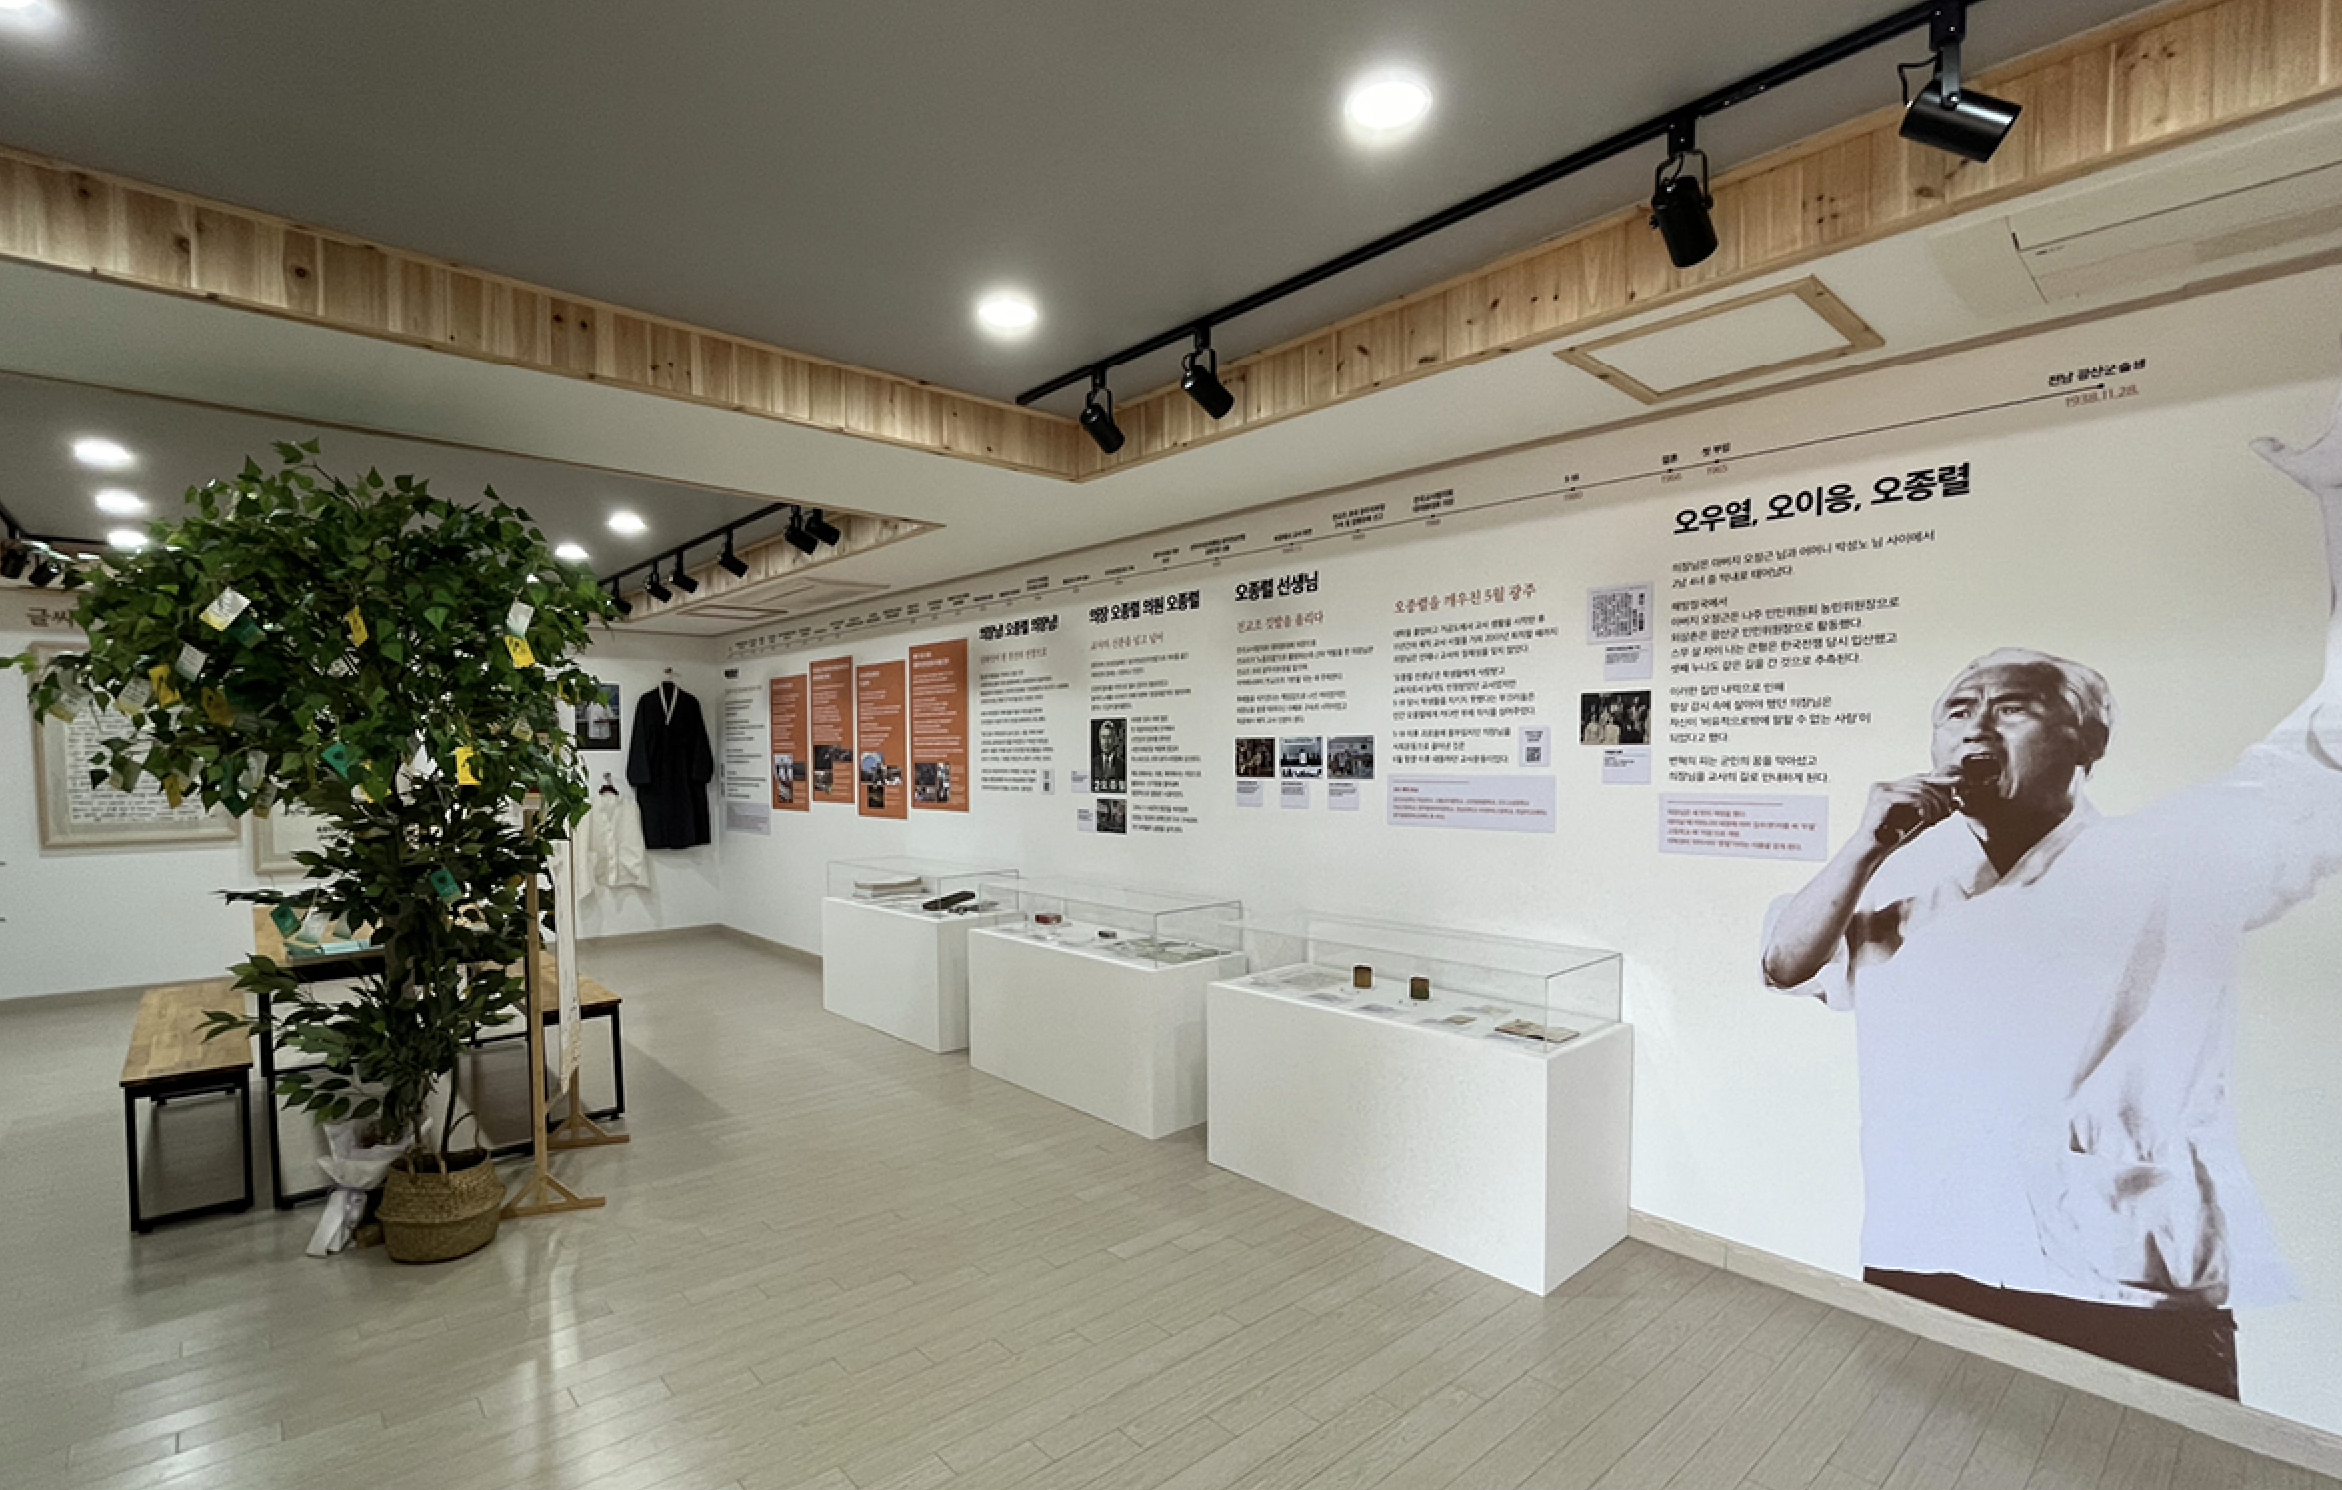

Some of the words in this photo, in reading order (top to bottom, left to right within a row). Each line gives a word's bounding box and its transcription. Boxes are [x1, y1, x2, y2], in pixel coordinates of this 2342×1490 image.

[1673, 499, 1758, 534] 오우열,
[1766, 483, 1861, 521] 오이응,
[1870, 463, 1970, 505] 오종렬
[1234, 578, 1274, 601] 오종렬
[1276, 571, 1319, 597] 선생님
